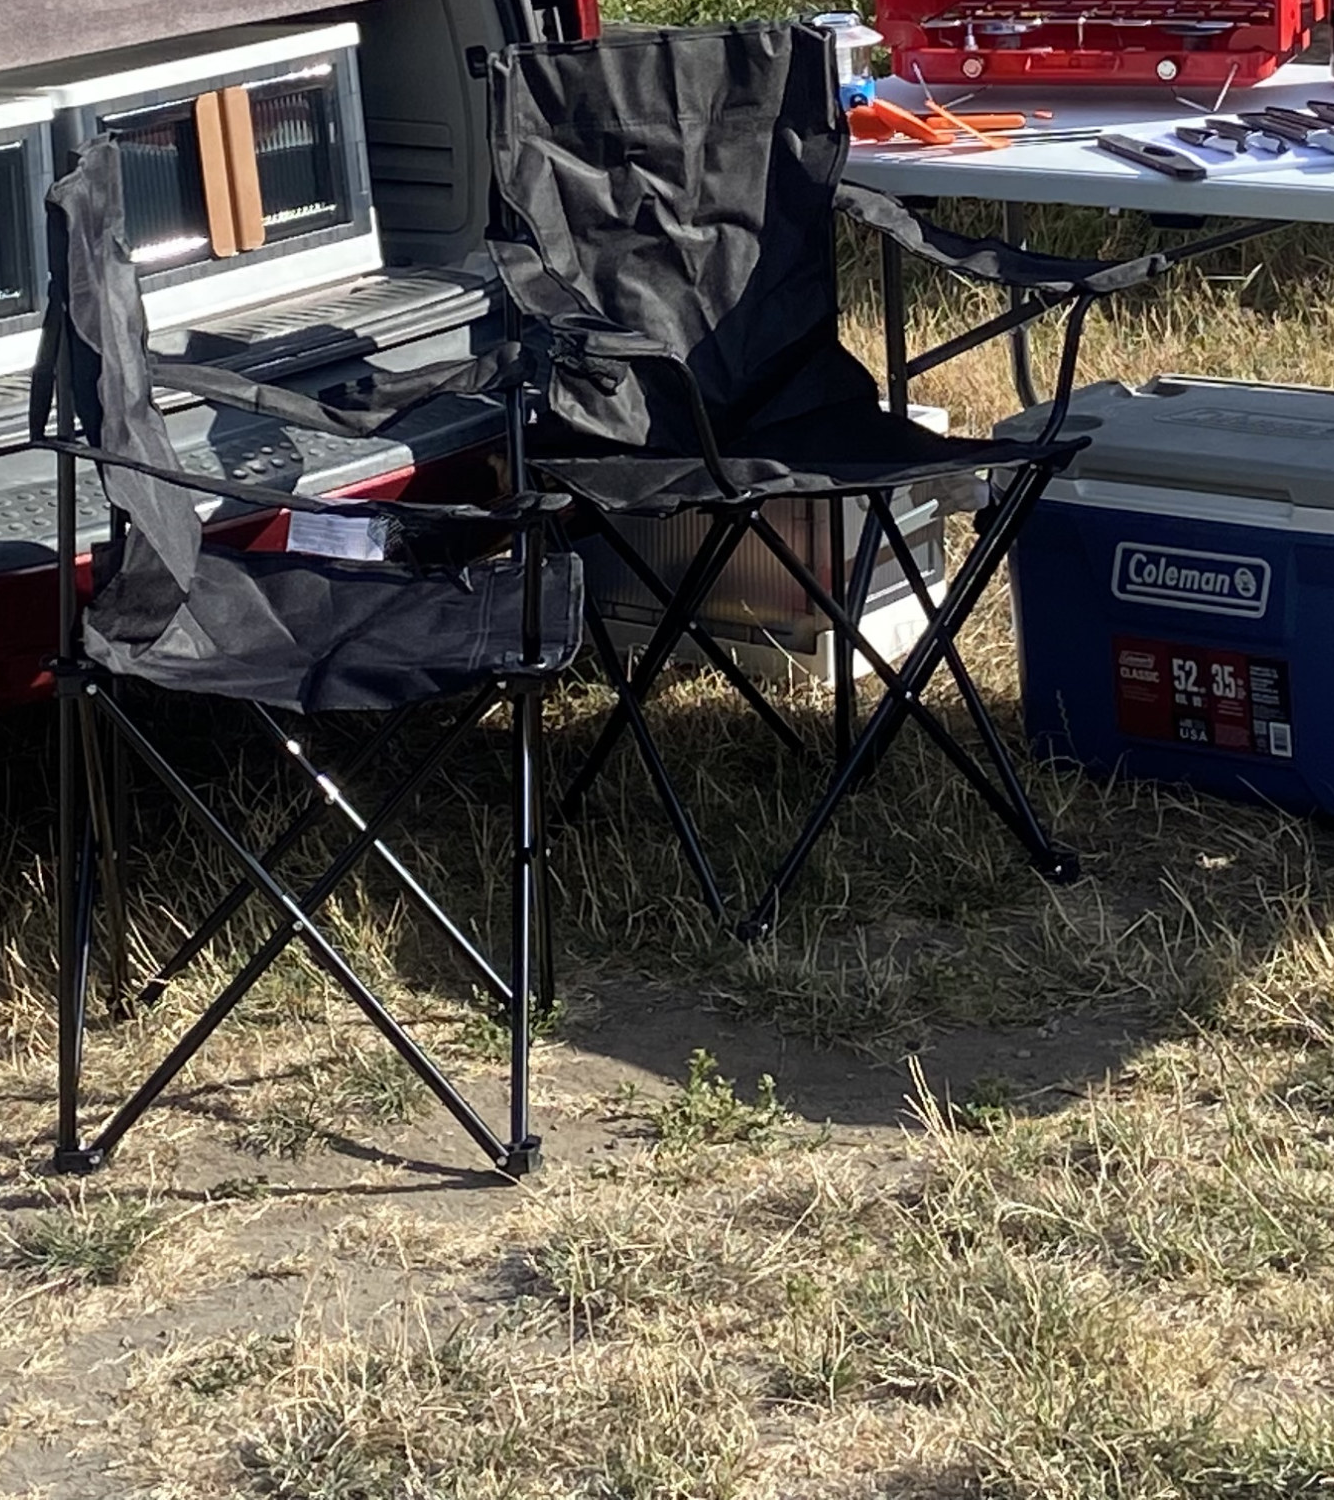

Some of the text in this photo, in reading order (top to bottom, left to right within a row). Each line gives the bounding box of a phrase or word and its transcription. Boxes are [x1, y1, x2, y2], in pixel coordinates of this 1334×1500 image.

[1128, 552, 1230, 595] Coleman
[1172, 658, 1199, 692] 52
[1180, 728, 1208, 742] USA
